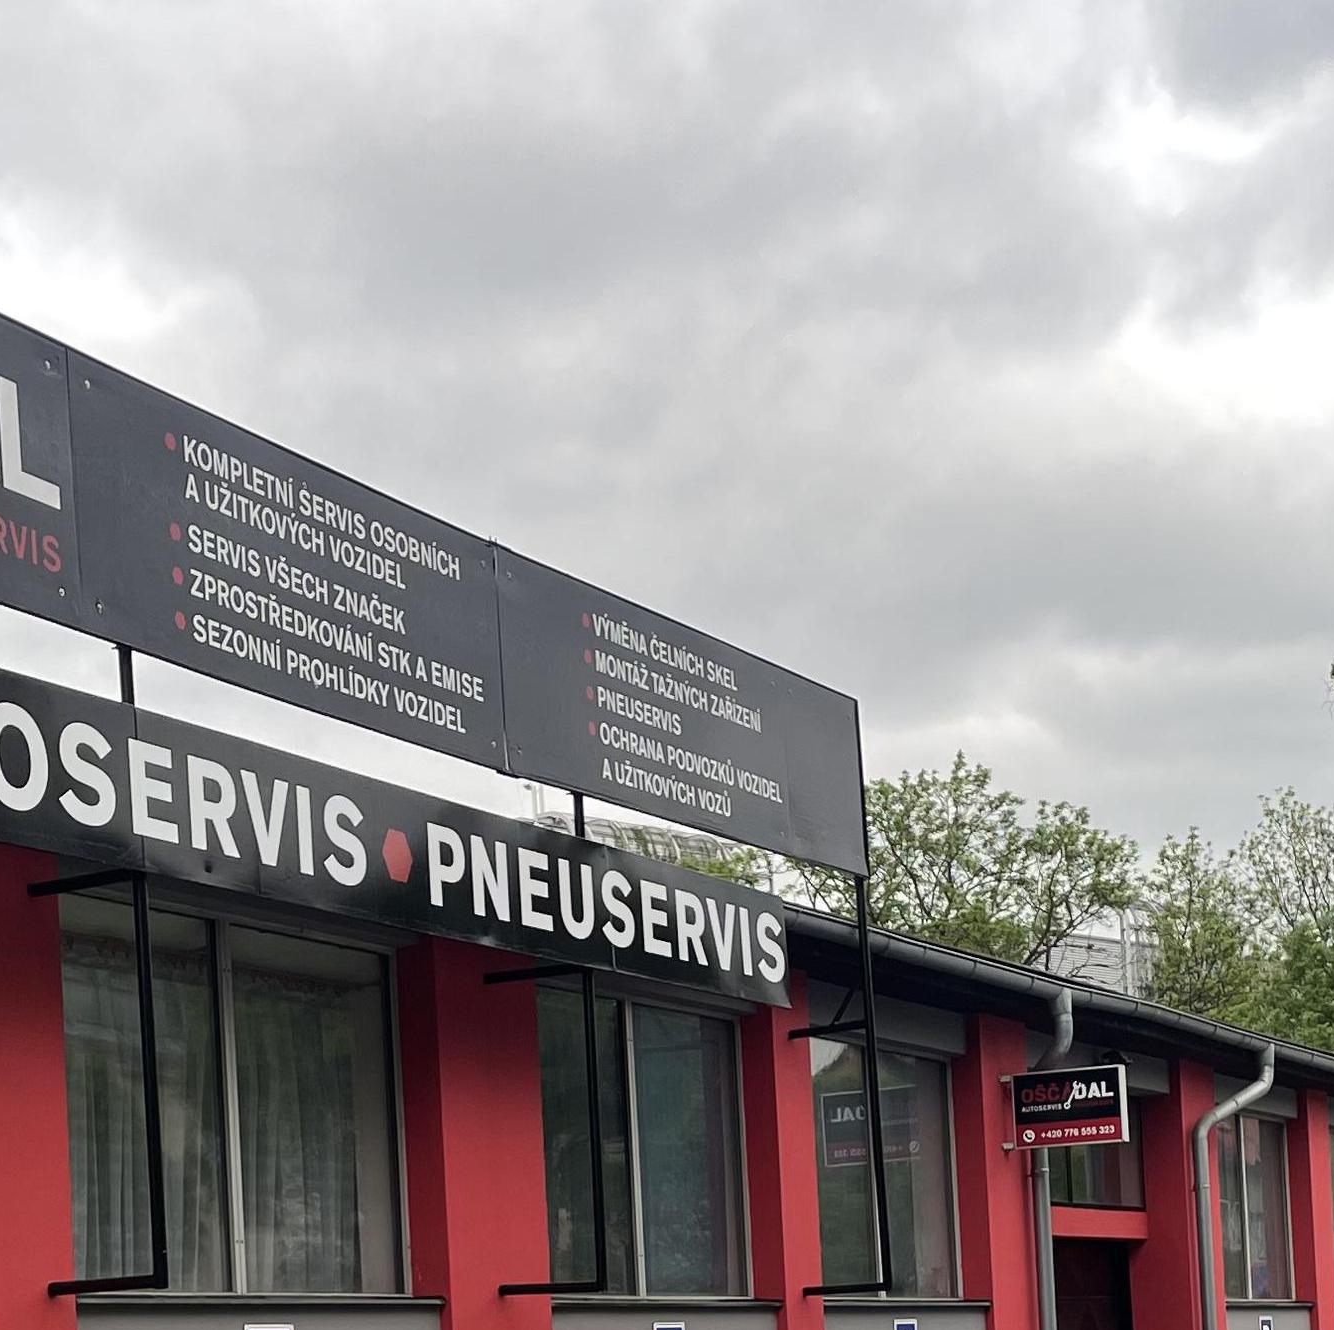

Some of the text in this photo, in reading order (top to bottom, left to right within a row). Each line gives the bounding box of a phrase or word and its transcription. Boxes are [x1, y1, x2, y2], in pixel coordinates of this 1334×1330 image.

[182, 434, 460, 580] KOMPLETNÍ SERVIS OSOBNÍCH
[185, 473, 406, 589] A UŽITKOVÝCH VOZIDEL
[187, 524, 406, 635] SERVIS VŠECH ZNAČEK
[189, 568, 484, 702] ZPROSTŘEDKOVÁNÍ STK A EMISE
[192, 614, 467, 734] SEZONNÍ PROHLÍDKY VOZIDEL
[592, 612, 738, 691] VÝMĚNA ČELNÍCH SKEL
[595, 649, 762, 733] MONTÁŽ TAŽNÝCH ZAŘÍZENÍ
[597, 686, 682, 736] PNEUSERVIS
[599, 722, 783, 804] OCHRANA PODVOZKŮ VOZIDEL
[602, 758, 732, 817] A UŽITKOVÝCH VOZŮ
[427, 823, 787, 985] PNEUSERVIS
